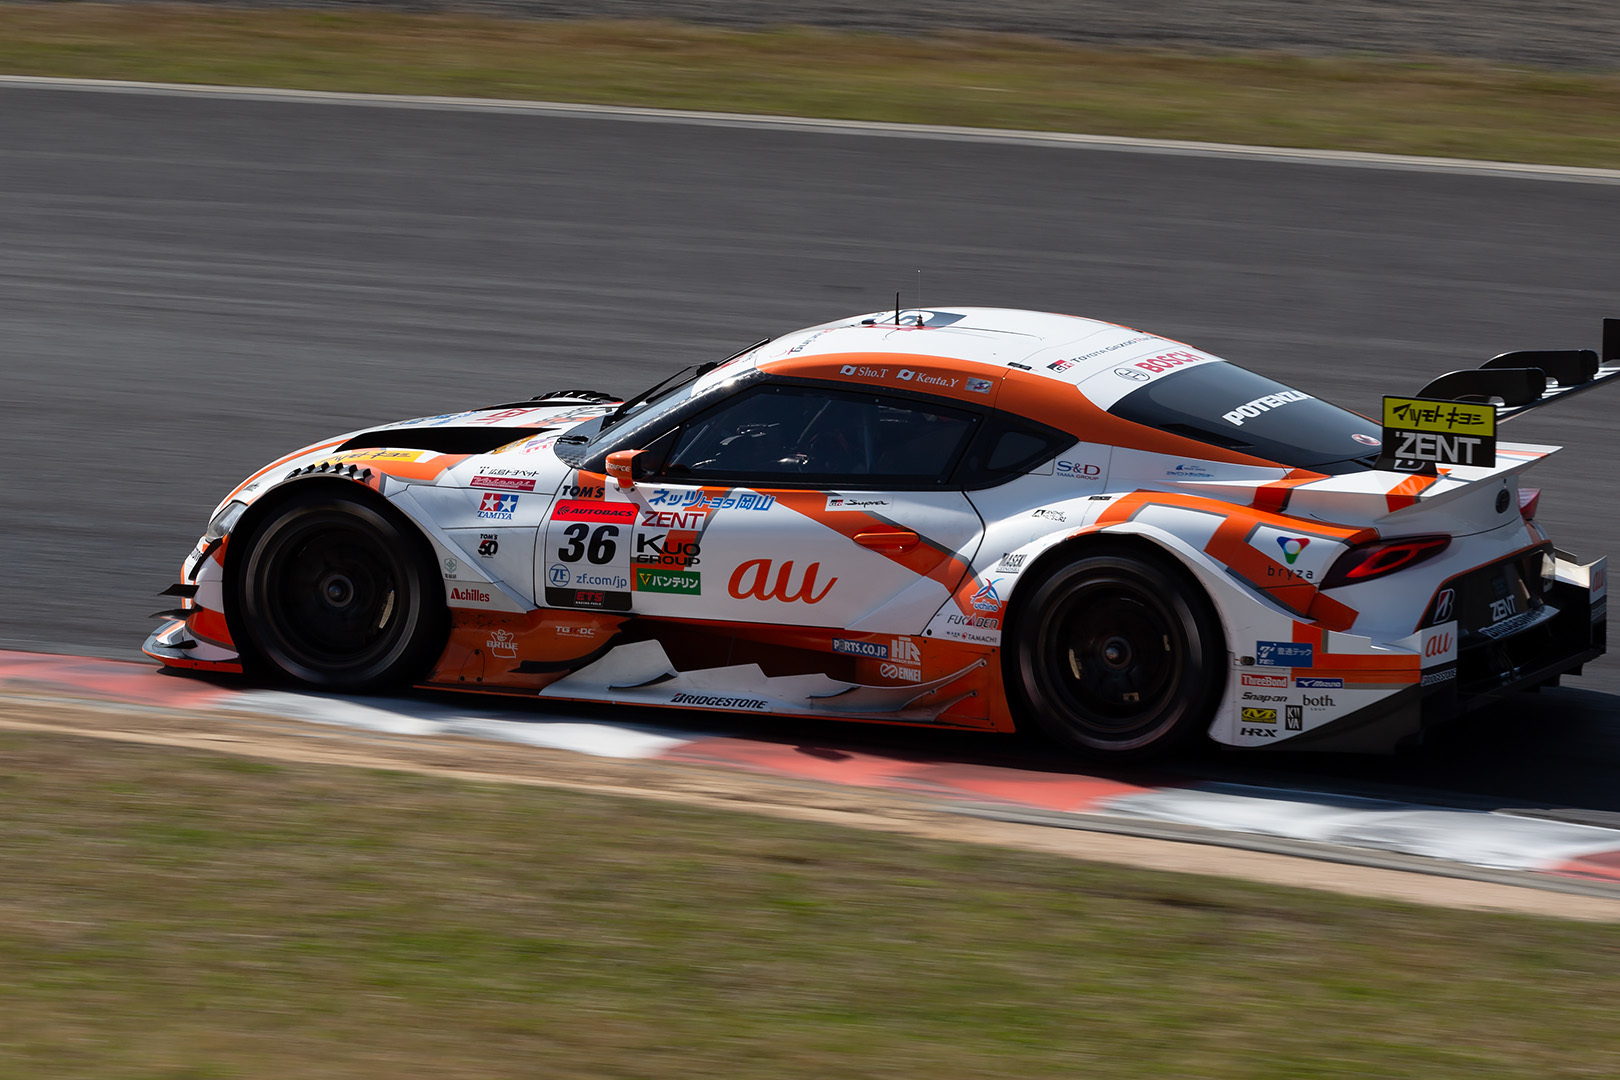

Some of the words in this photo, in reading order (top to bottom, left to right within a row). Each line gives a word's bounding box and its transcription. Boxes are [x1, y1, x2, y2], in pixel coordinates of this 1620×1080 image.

[1134, 350, 1205, 374] BOSCH
[857, 366, 889, 379] Sho.T
[915, 373, 959, 388] Kenta.Y
[1222, 390, 1316, 427] POTENZA
[1393, 403, 1485, 430] マツモトキヨシ
[1395, 431, 1482, 465] ZENT
[1056, 460, 1101, 476] S&D
[561, 485, 605, 498] TOM'S
[648, 489, 776, 511] ネッツトヨタ岡山
[844, 499, 889, 508] Supra
[477, 510, 512, 520] TAMIYA
[570, 508, 634, 517] AUTOBACS
[641, 511, 705, 529] ZENT
[558, 523, 619, 565] 36
[636, 533, 701, 556] KUO
[636, 554, 701, 567] GROUP
[1267, 565, 1314, 580] bryza
[576, 573, 627, 588] zf.com/jp
[652, 576, 699, 589] バンテリン
[727, 558, 839, 604] au
[450, 588, 490, 602] Achilles
[576, 591, 604, 602] ETS
[973, 601, 998, 612] uchino
[1489, 595, 1517, 622] ZENT
[486, 640, 518, 650] BRIDE
[1425, 632, 1453, 658] au
[898, 667, 921, 682] ENKEI
[1242, 675, 1288, 688] ThreeBond
[670, 692, 768, 709] BRIDGESTONE
[1241, 692, 1288, 703] Snap-on
[1240, 727, 1279, 738] HRX
